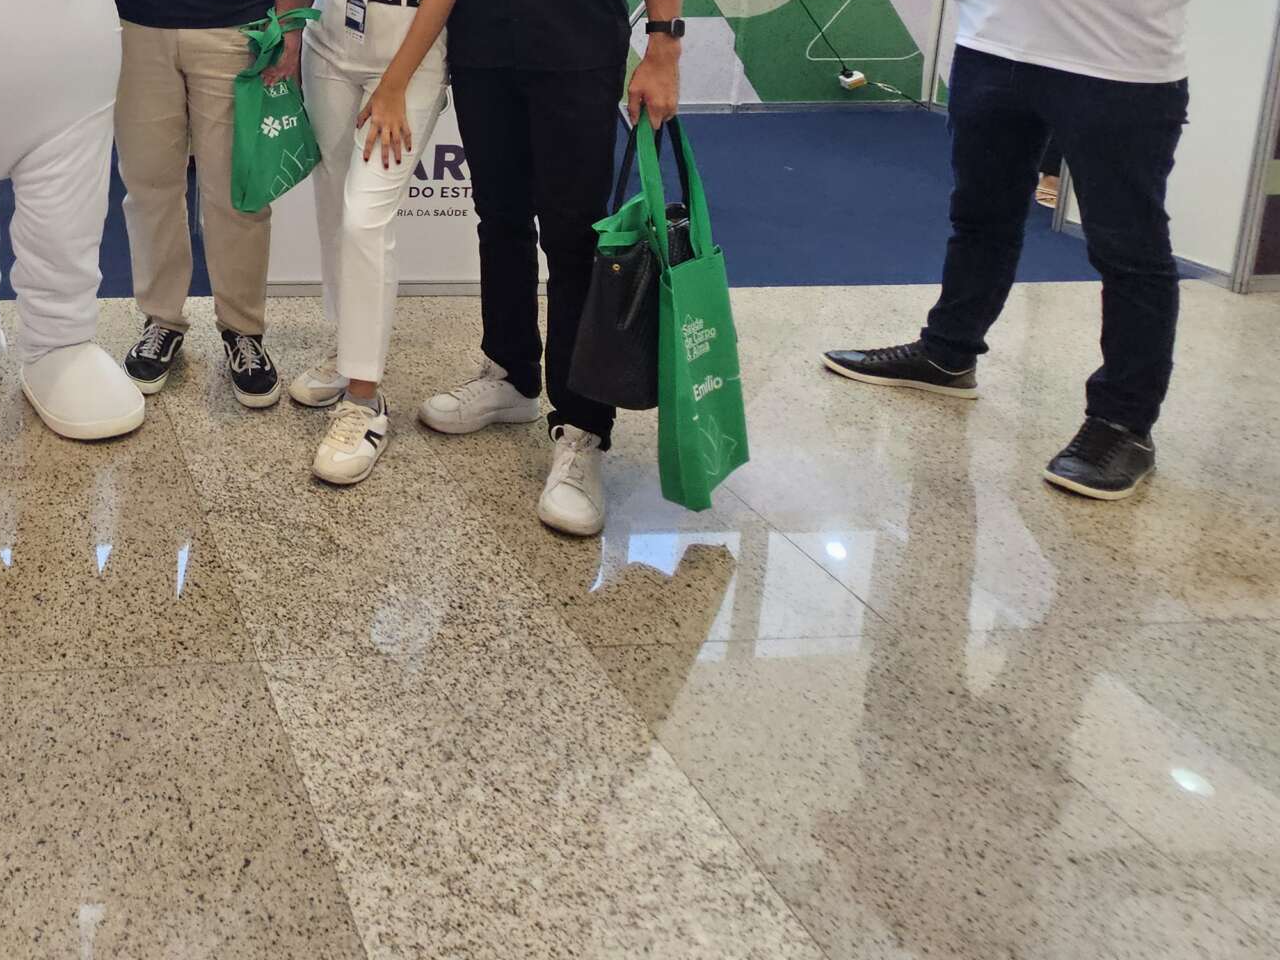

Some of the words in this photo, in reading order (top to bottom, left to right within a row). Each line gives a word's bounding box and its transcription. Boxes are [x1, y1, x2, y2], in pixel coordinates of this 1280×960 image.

[409, 186, 434, 198] DO
[440, 186, 472, 198] EST
[416, 209, 430, 217] DA
[433, 207, 468, 217] SAÚDE
[692, 375, 723, 401] Emilio
